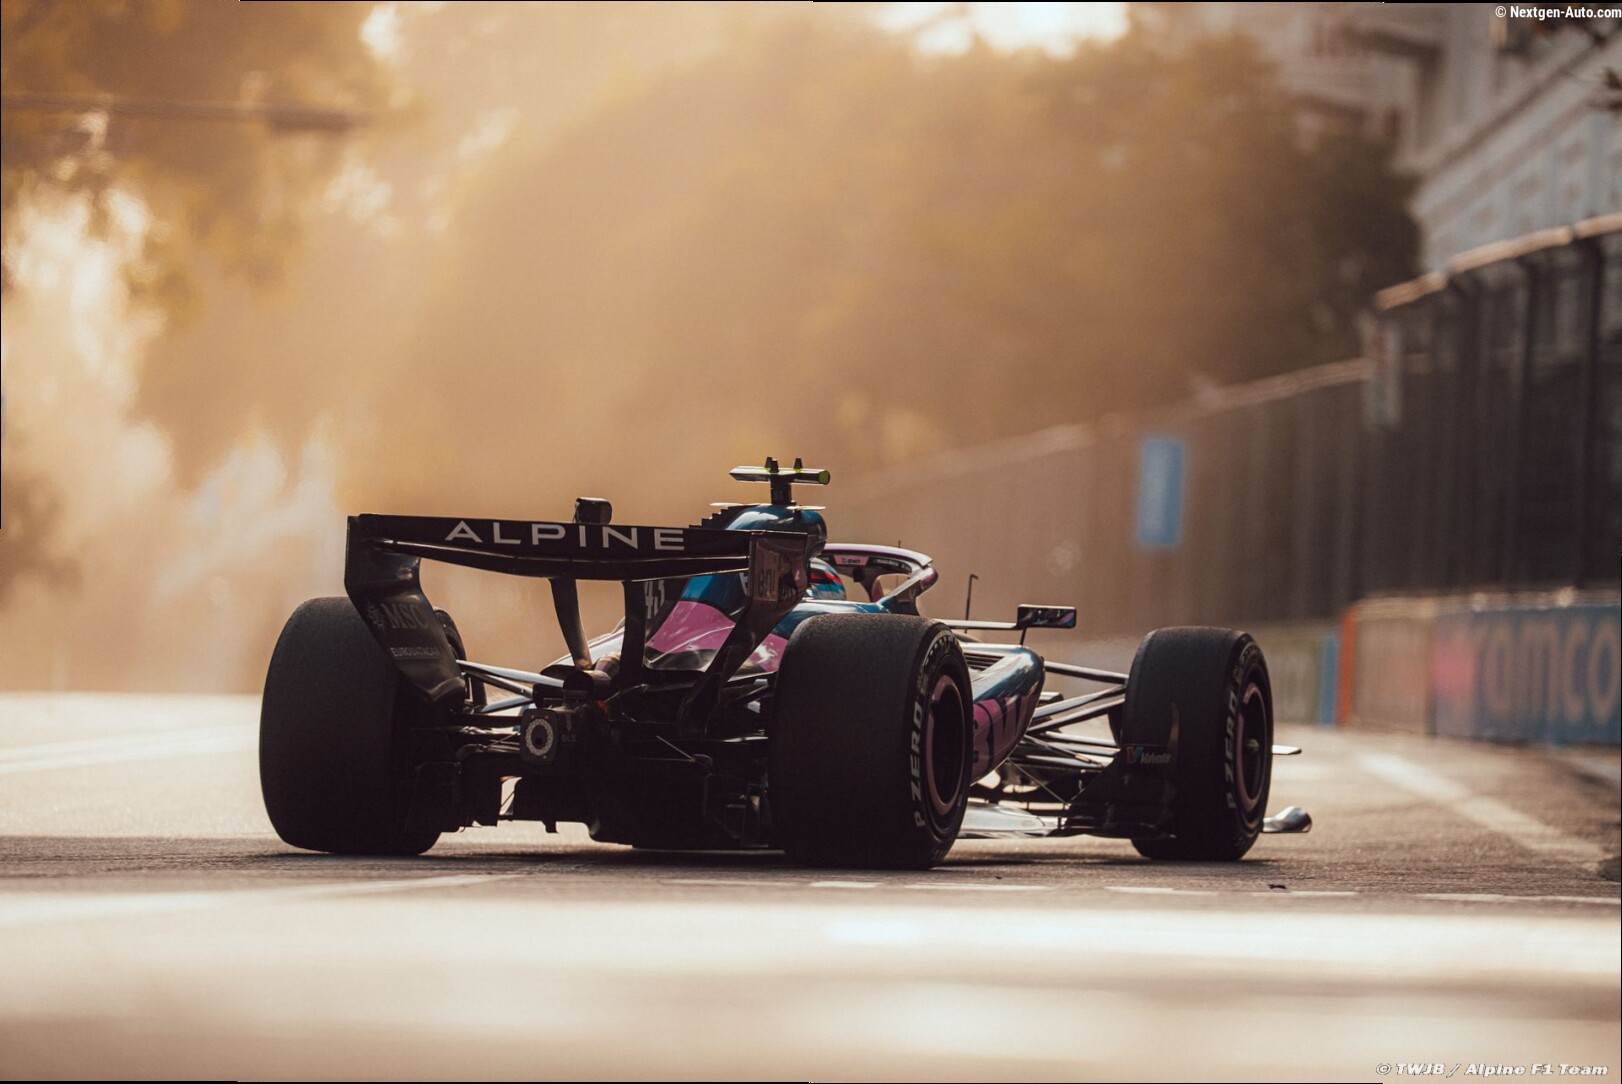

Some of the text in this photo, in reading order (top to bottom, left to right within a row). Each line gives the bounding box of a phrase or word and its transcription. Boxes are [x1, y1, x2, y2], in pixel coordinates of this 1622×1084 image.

[445, 520, 685, 550] ALPINE
[380, 602, 430, 629] MSC
[909, 702, 924, 802] ZERO
[1225, 690, 1238, 783] ZERO
